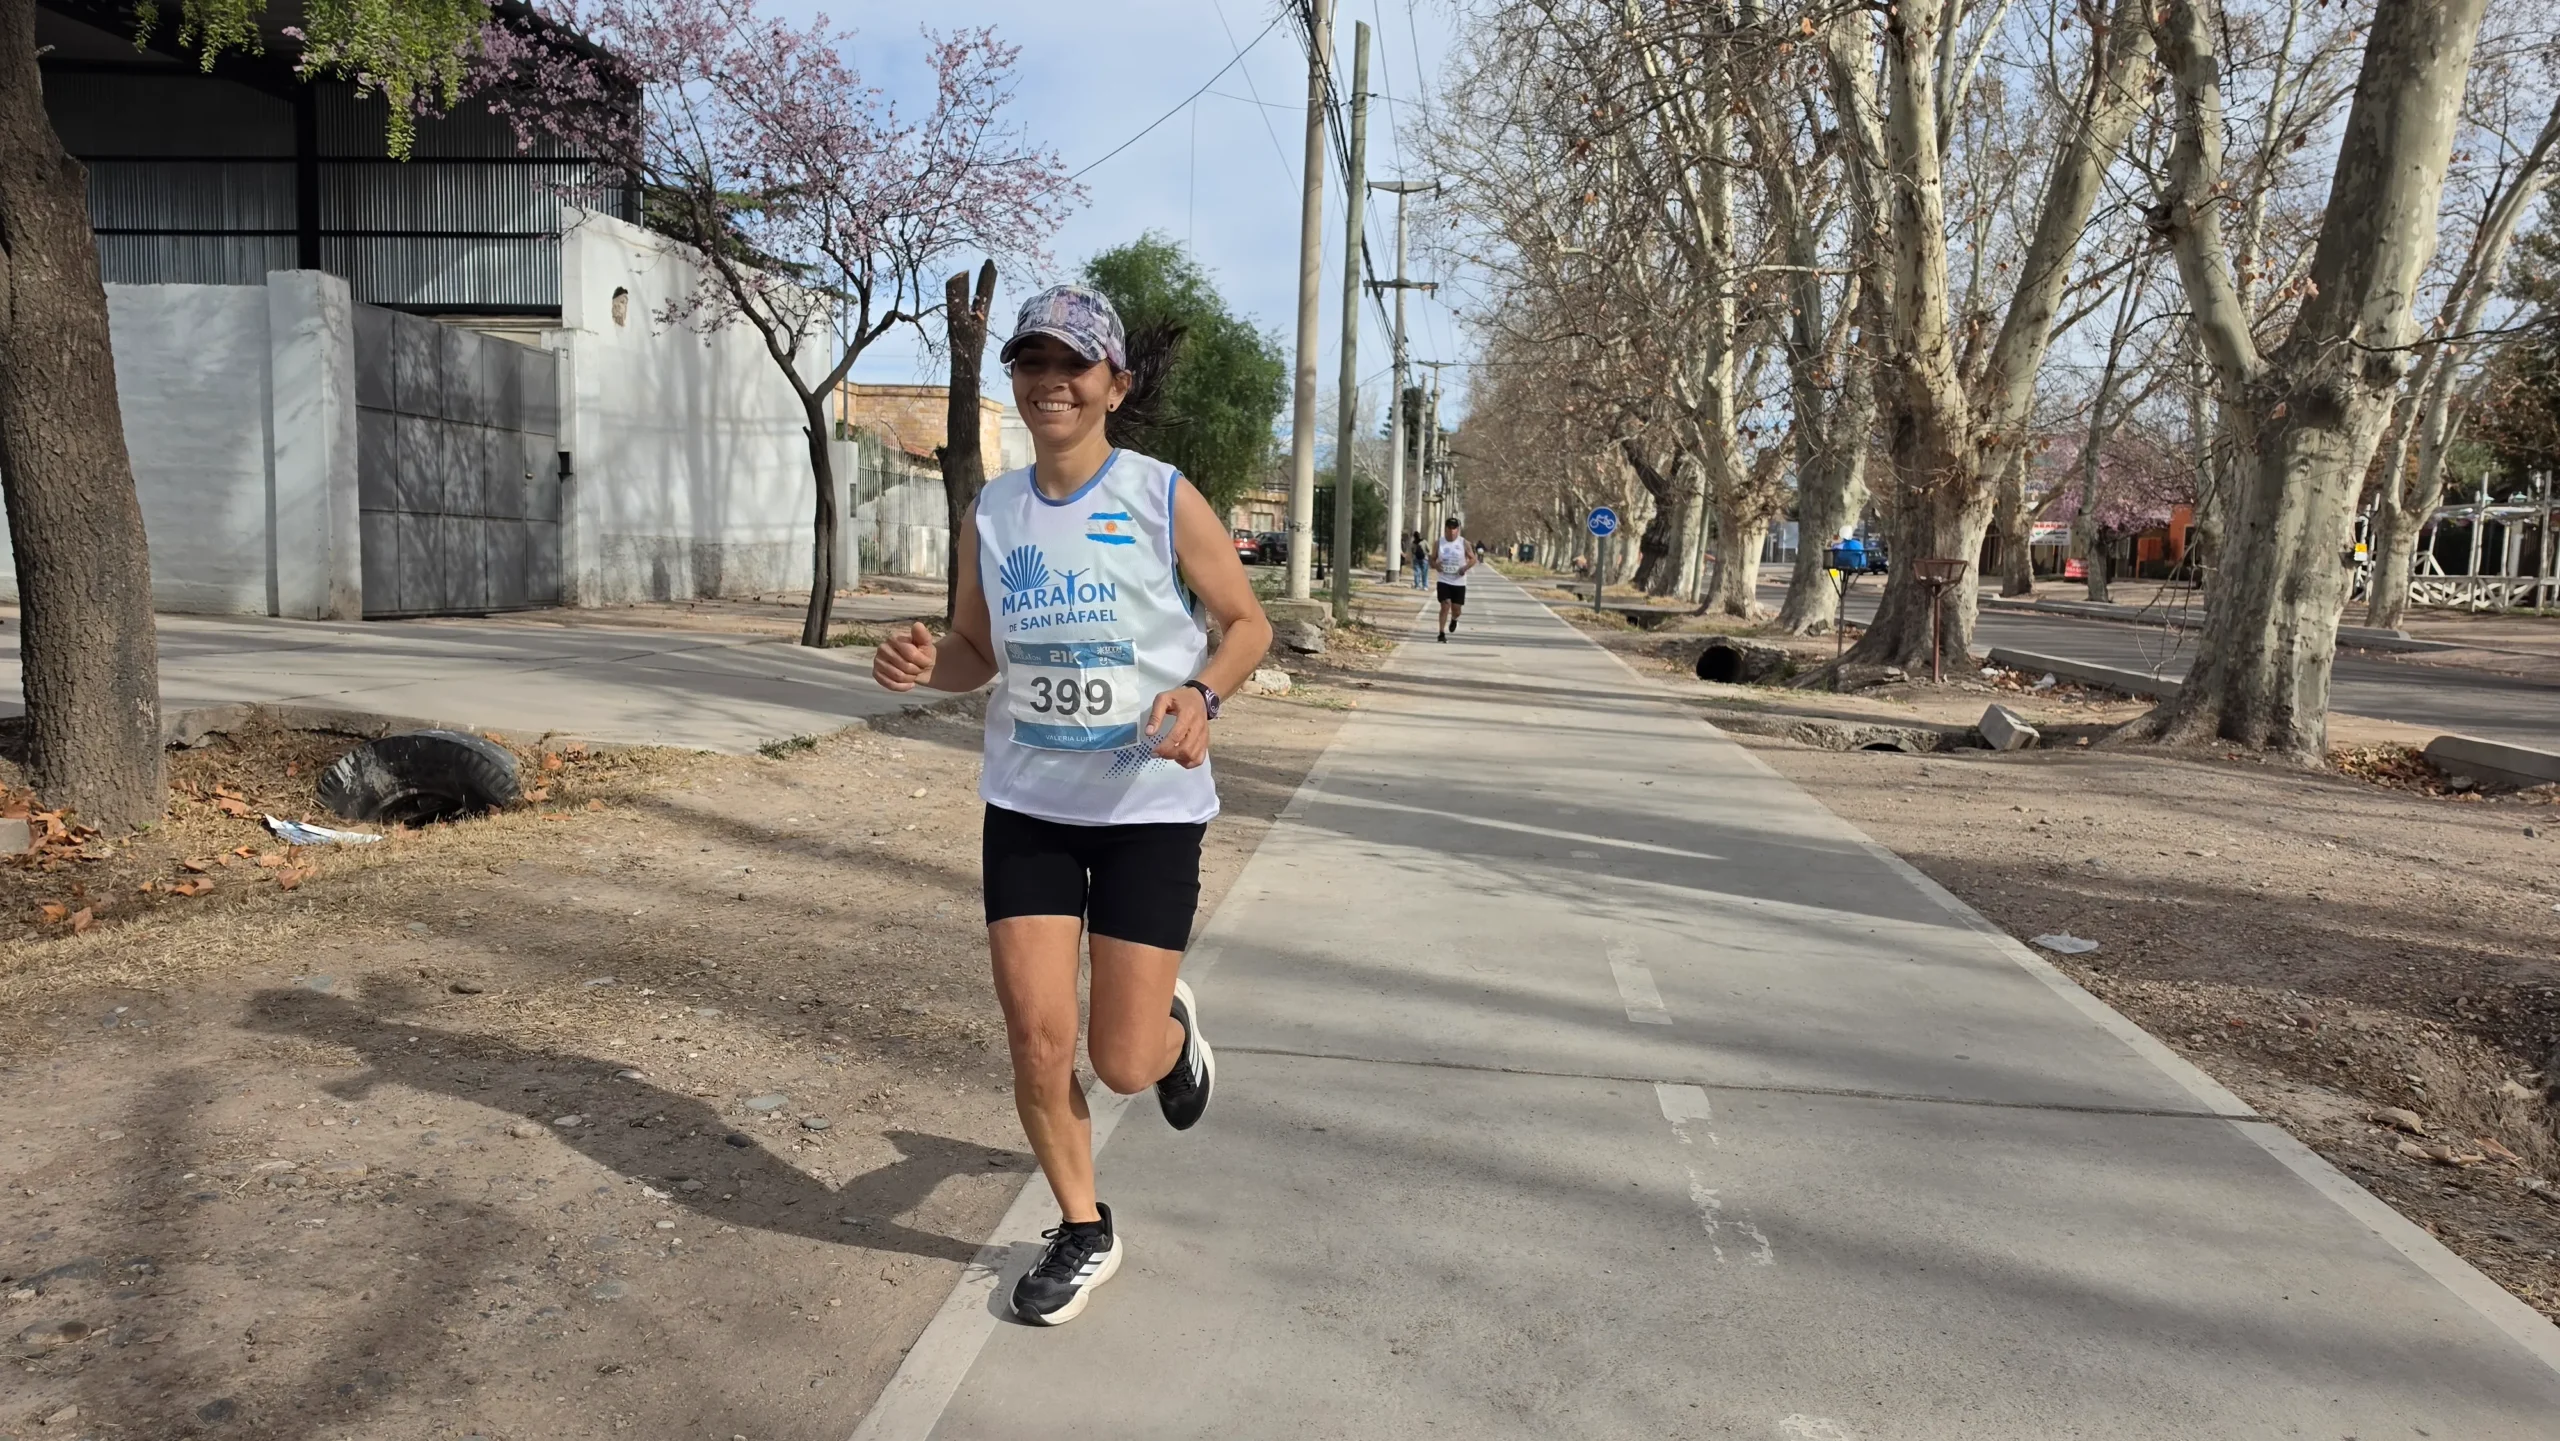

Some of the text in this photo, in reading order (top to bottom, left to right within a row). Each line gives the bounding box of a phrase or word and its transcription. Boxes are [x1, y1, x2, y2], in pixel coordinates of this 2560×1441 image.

[1002, 572, 1117, 616] MARATON
[1009, 609, 1118, 633] DE SAN RAFAEL
[1049, 649, 1081, 664] 21K
[1029, 676, 1113, 716] 399
[1045, 734, 1075, 742] VALERIA
